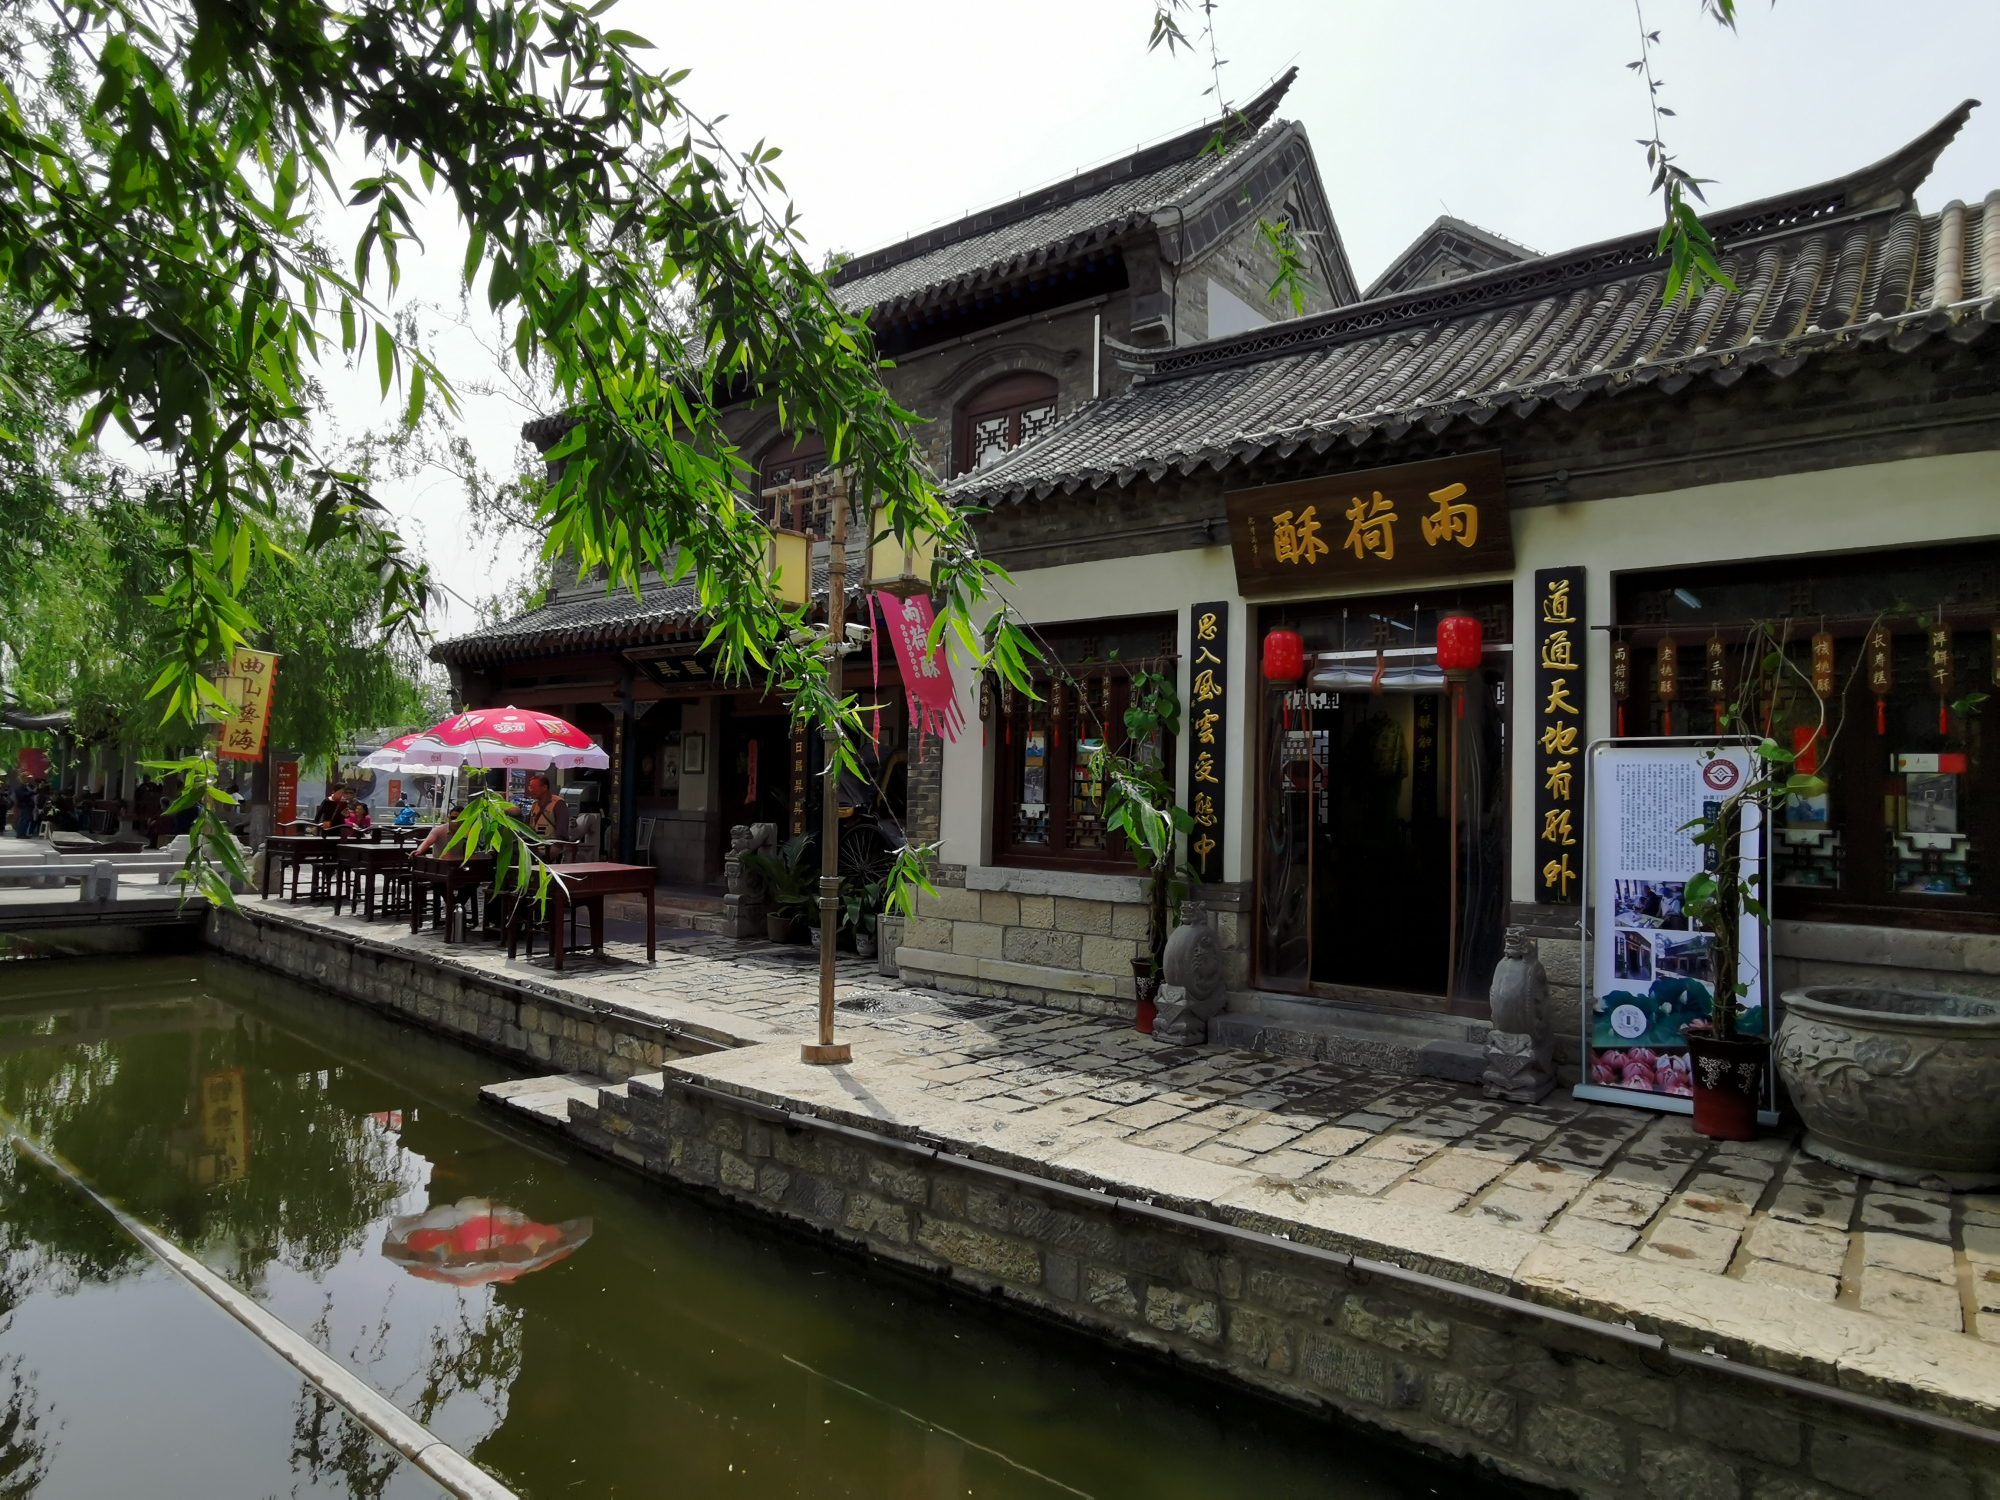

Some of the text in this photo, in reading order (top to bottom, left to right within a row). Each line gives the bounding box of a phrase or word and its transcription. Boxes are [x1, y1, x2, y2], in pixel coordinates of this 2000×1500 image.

[1541, 578, 1580, 897] 道通天地有形外
